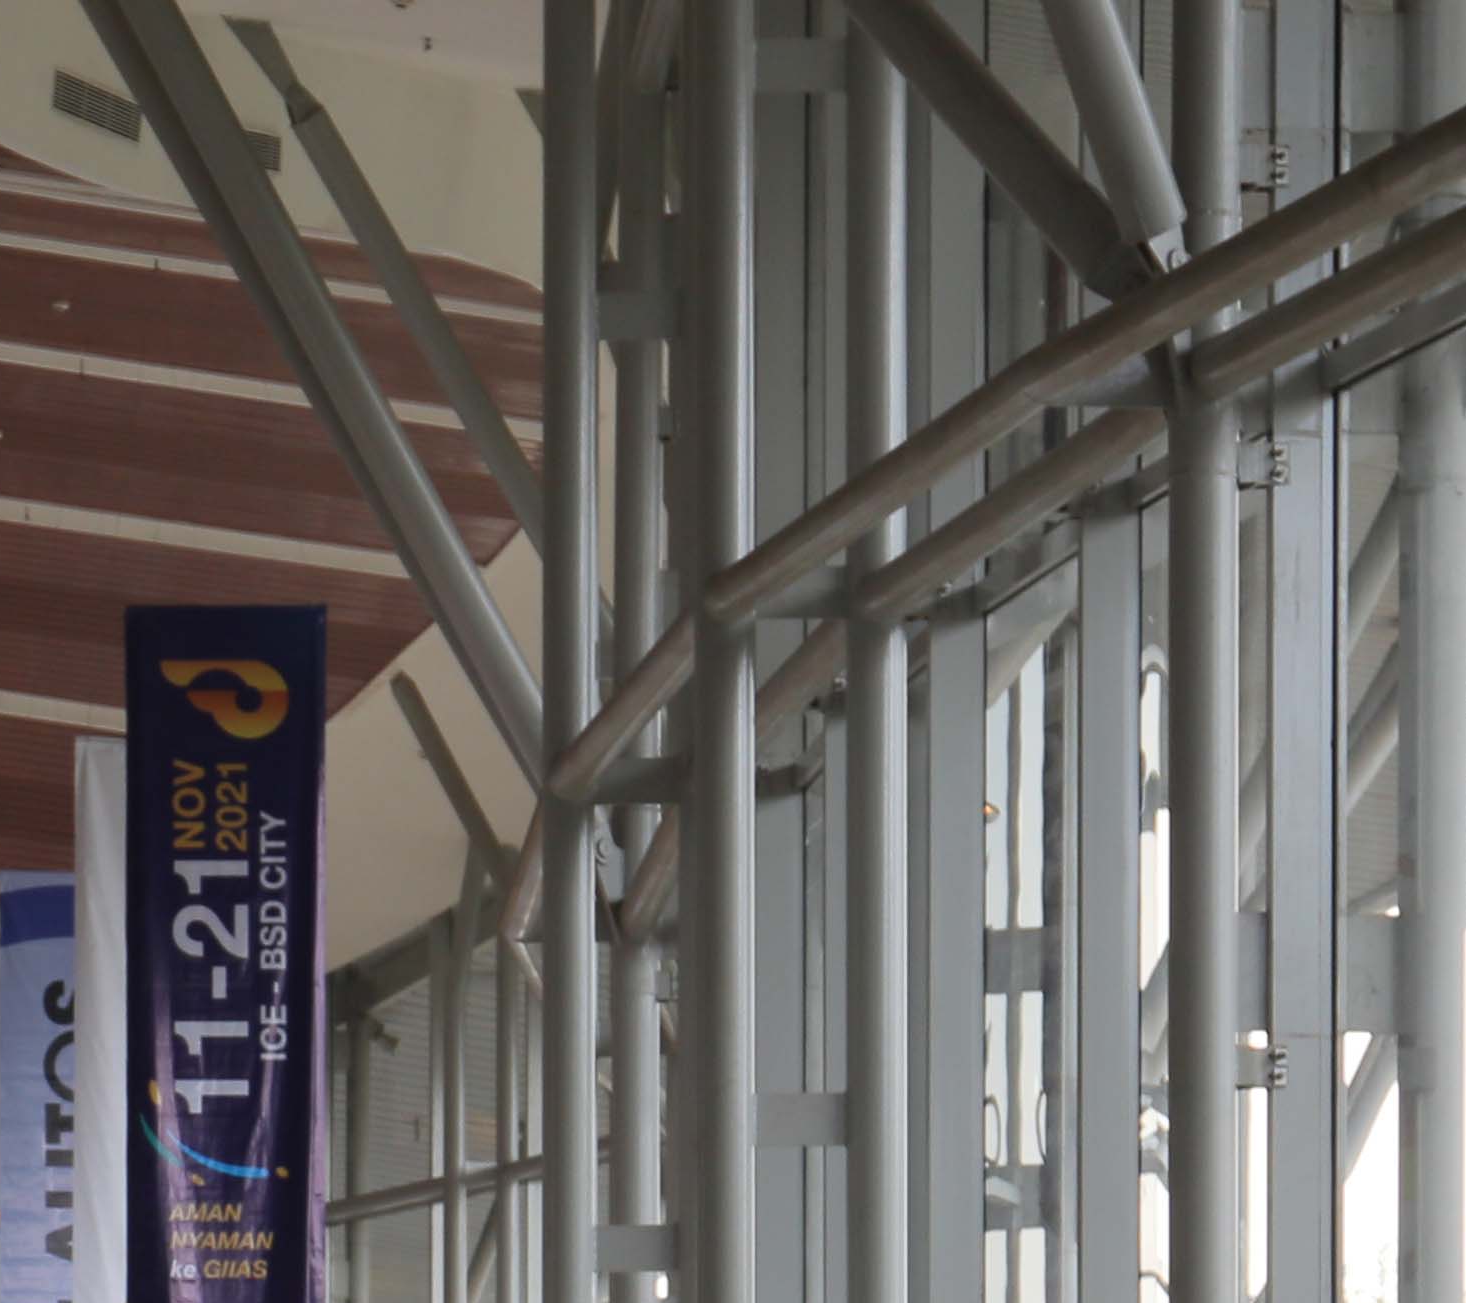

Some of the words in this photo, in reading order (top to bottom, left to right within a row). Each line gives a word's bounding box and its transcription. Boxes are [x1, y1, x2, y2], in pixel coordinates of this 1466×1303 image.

[172, 758, 206, 849] NOV
[215, 763, 248, 852] 2021
[259, 810, 287, 889] CITY
[260, 899, 287, 971] BSD
[172, 859, 249, 1115] 11-21
[260, 1004, 287, 1061] ICE
[169, 1202, 243, 1221] AMAN
[170, 1231, 274, 1250] NYAMAN
[170, 1259, 196, 1279] ke
[203, 1259, 268, 1279] GIIAS
